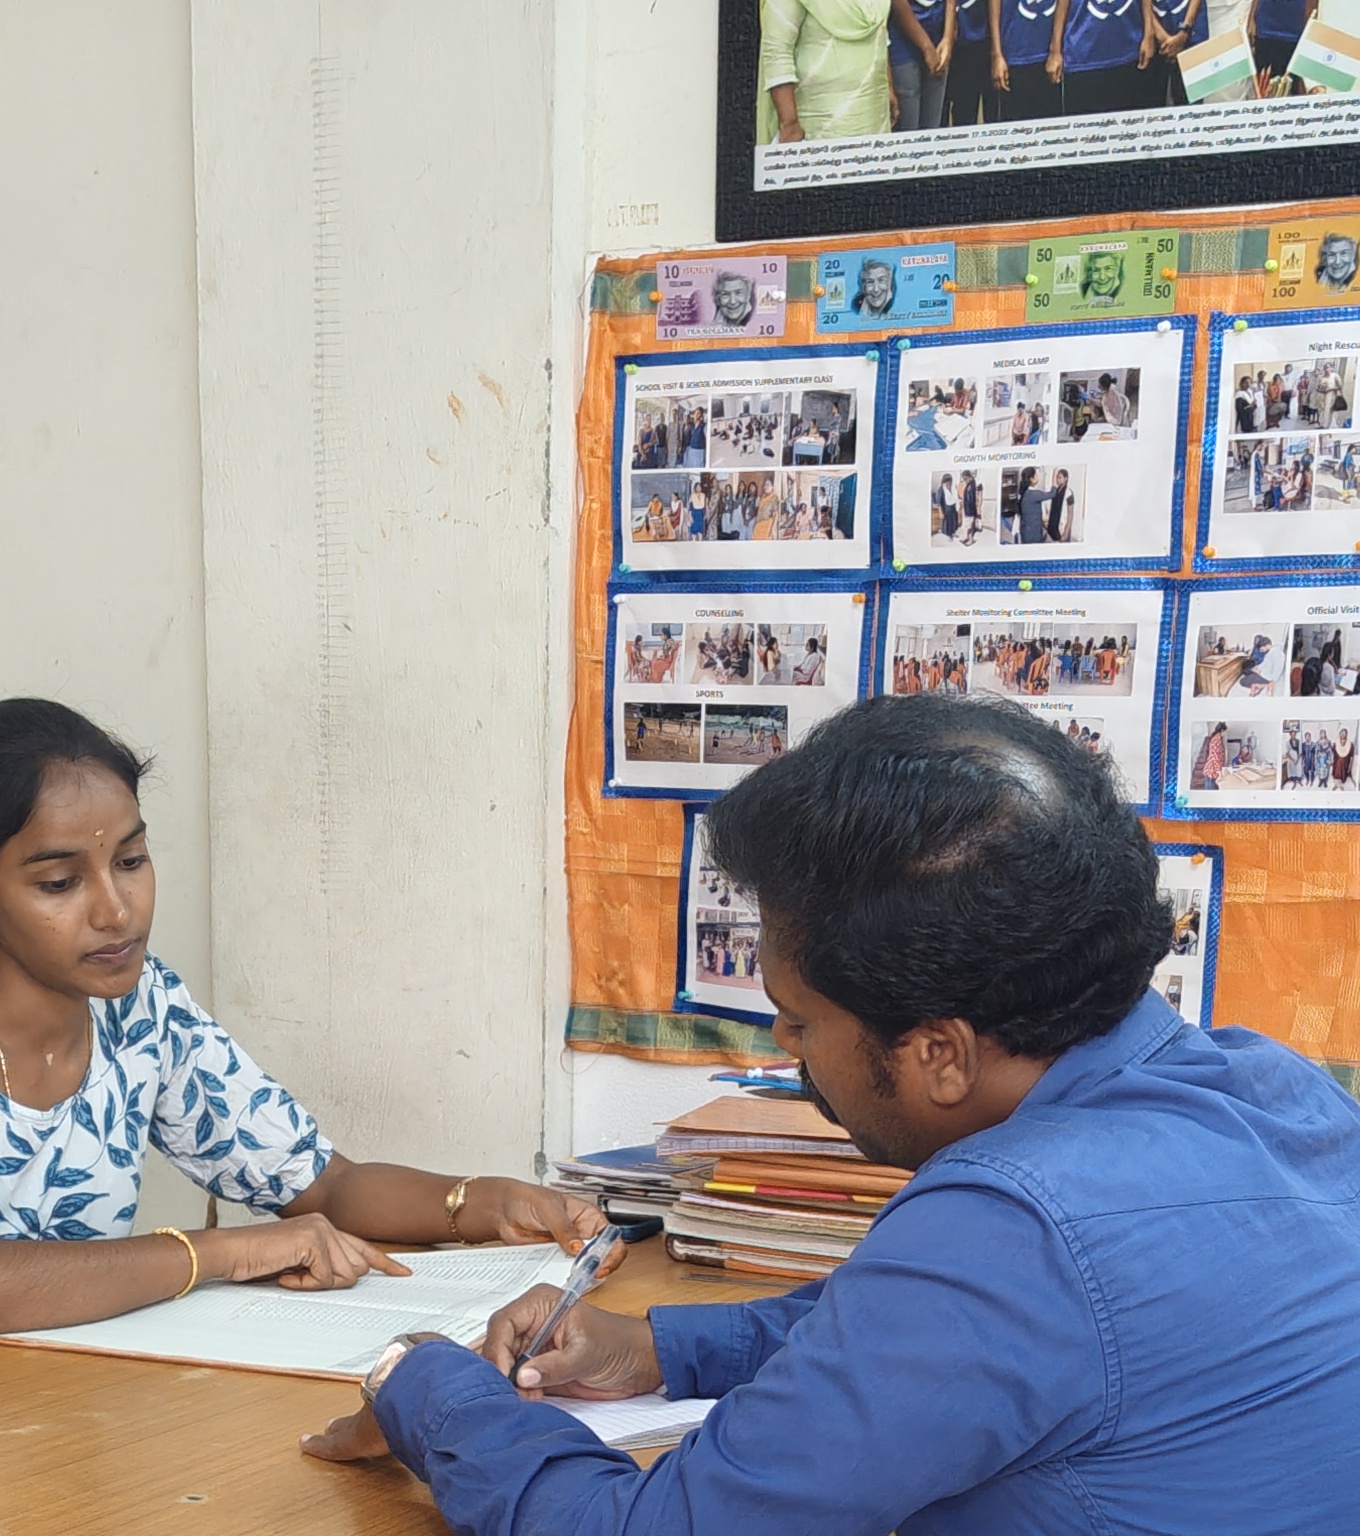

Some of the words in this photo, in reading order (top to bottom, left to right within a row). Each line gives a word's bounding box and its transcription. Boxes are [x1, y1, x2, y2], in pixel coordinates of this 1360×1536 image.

[1157, 238, 1174, 253] 50
[1036, 248, 1053, 262] 50
[762, 262, 778, 274] 10
[824, 260, 840, 270] 20
[664, 264, 680, 280] 10
[1154, 284, 1171, 299] 50
[1272, 286, 1296, 298] 100
[1034, 292, 1050, 308] 50
[822, 314, 839, 325] 20
[663, 328, 678, 338] 10
[759, 324, 775, 336] 10
[1308, 342, 1333, 353] Night
[993, 358, 1026, 369] MEDICAL
[1027, 356, 1050, 366] CAMP
[814, 374, 834, 384] CLASS
[953, 453, 987, 464] GROWTH
[988, 451, 1036, 462] MONITORING
[694, 608, 744, 618] COUNSELLING
[972, 608, 1012, 618] Monitoring
[1013, 608, 1054, 617] Committee
[1055, 608, 1086, 618] Meeting
[1306, 604, 1339, 616] Official
[1340, 604, 1360, 614] Visit
[695, 690, 724, 699] SPORTS
[1040, 701, 1074, 711] Meeting
